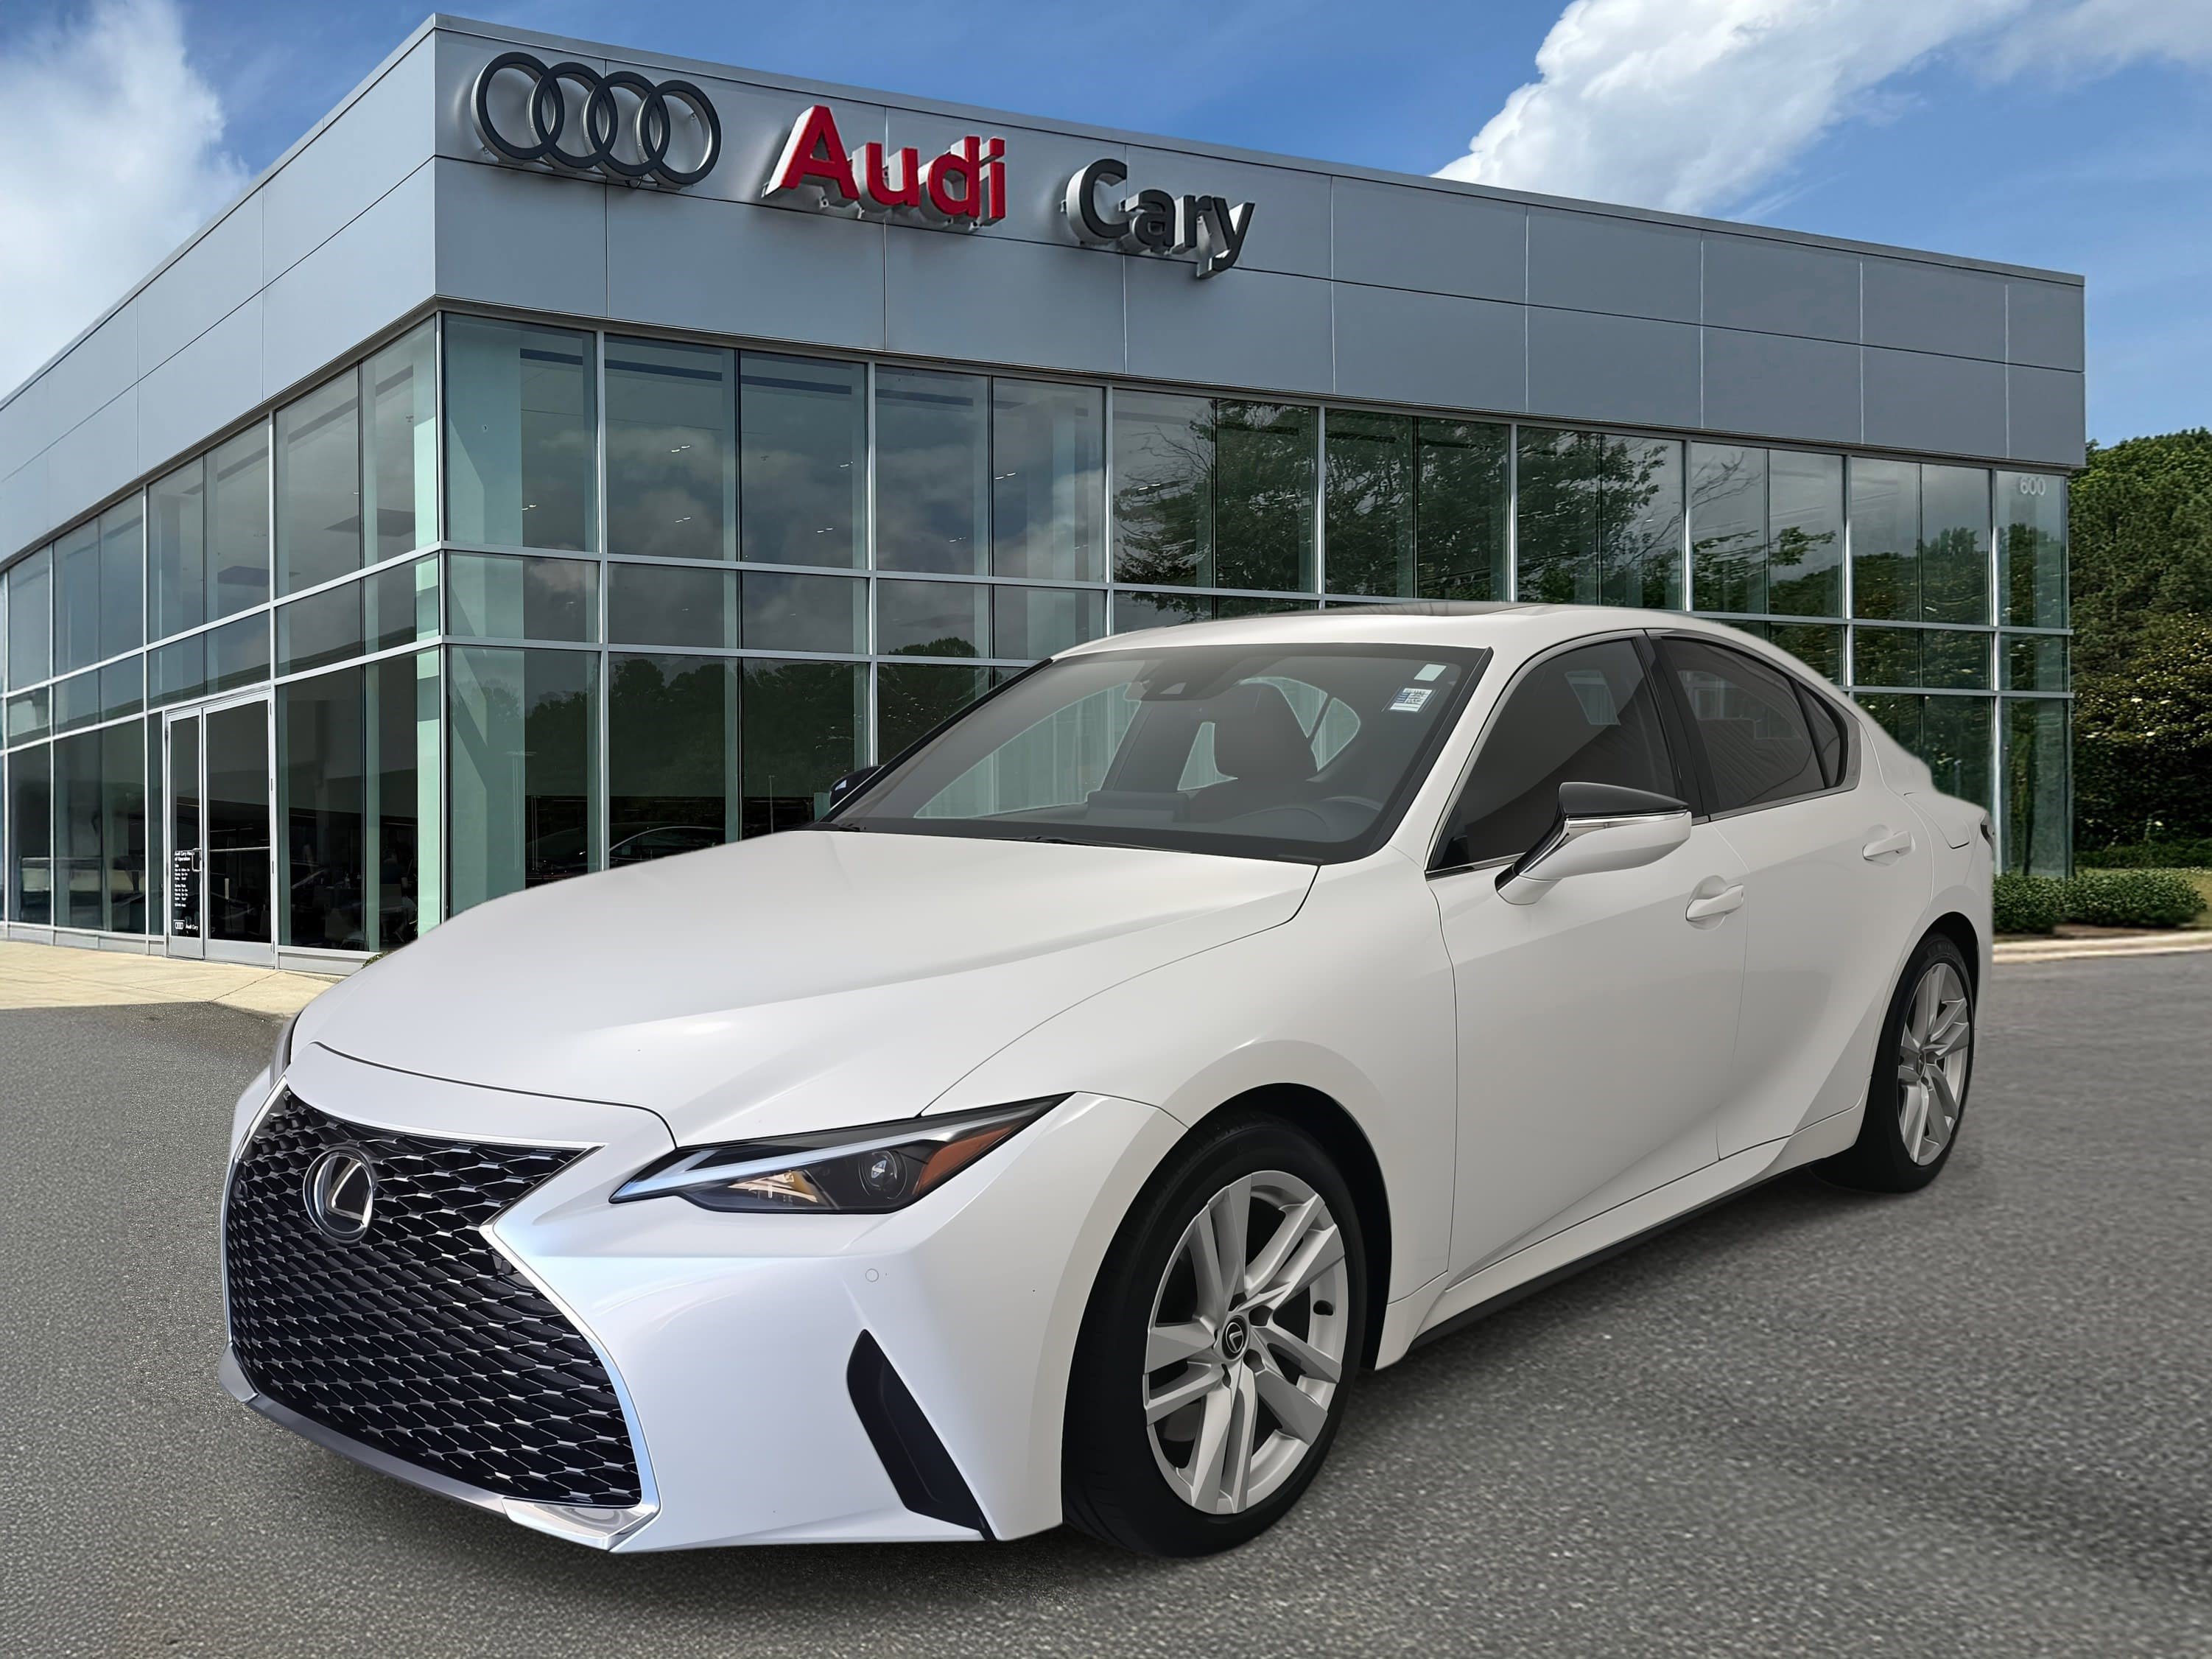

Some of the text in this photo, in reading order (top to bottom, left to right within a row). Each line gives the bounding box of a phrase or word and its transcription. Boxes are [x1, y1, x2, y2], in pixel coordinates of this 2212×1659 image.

[763, 105, 1256, 278] Audi Cary
[2020, 477, 2046, 496] 600
